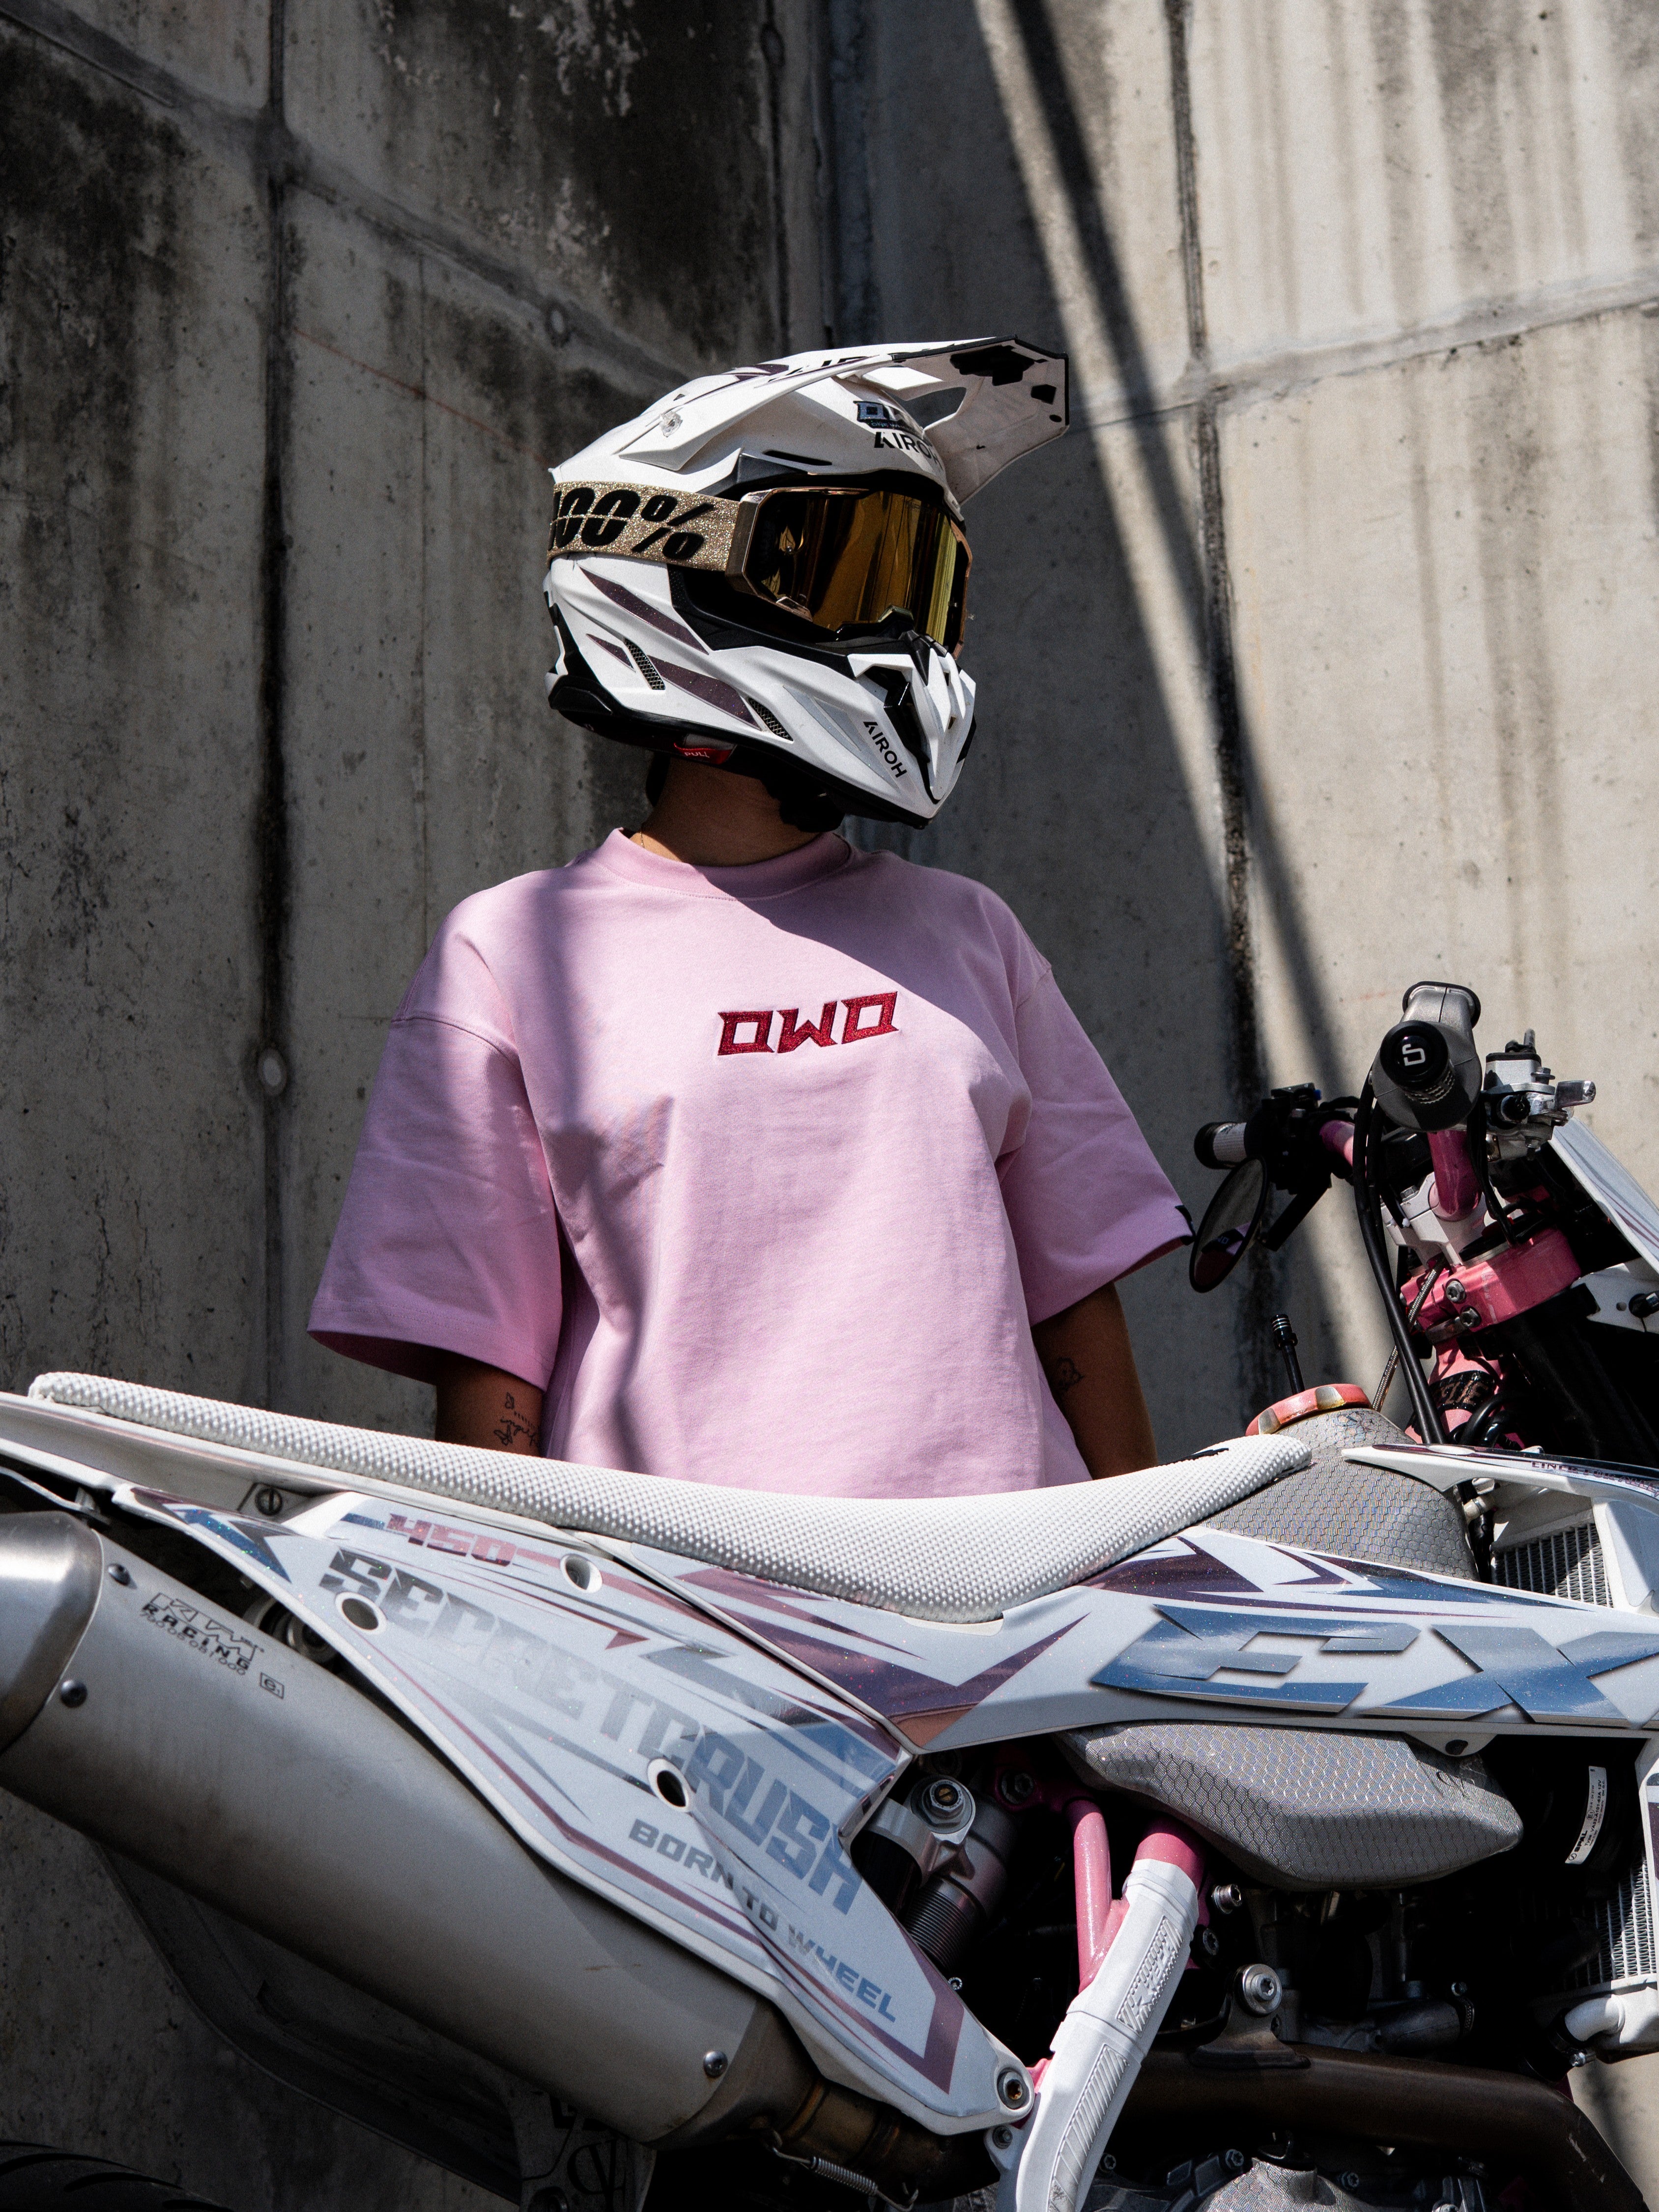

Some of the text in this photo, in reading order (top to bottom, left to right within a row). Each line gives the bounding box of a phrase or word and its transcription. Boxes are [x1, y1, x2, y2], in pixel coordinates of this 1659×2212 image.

[874, 431, 943, 470] AIROH
[863, 721, 908, 778] AIROH
[717, 991, 899, 1056] OWO
[386, 1513, 516, 1566] 450
[142, 1603, 250, 1670] RACING
[150, 1592, 257, 1663] KTM
[1573, 1830, 1588, 1852] SPAL
[629, 1819, 896, 2023] BORN TO WHEEL
